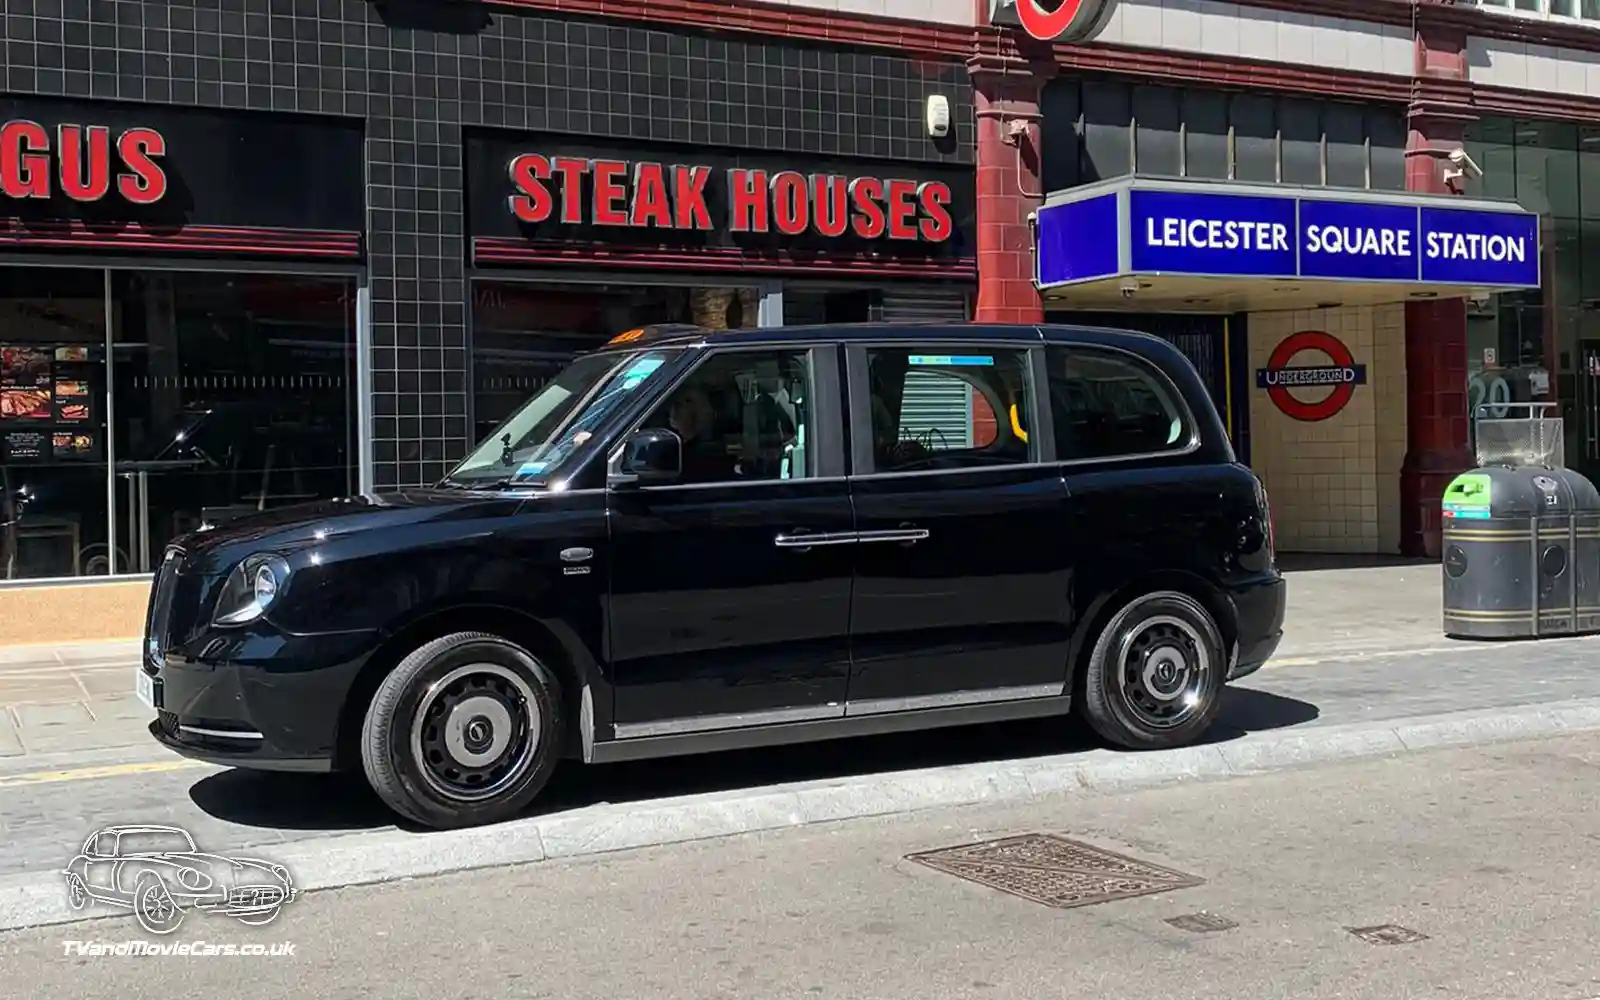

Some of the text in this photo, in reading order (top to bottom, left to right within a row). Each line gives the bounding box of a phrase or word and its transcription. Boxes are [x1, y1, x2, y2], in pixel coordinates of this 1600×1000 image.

[508, 153, 953, 242] STEAK HOUSES
[1147, 217, 1526, 262] LEICESTER SQUARE STATION
[1266, 368, 1355, 385] UNDERGROUND
